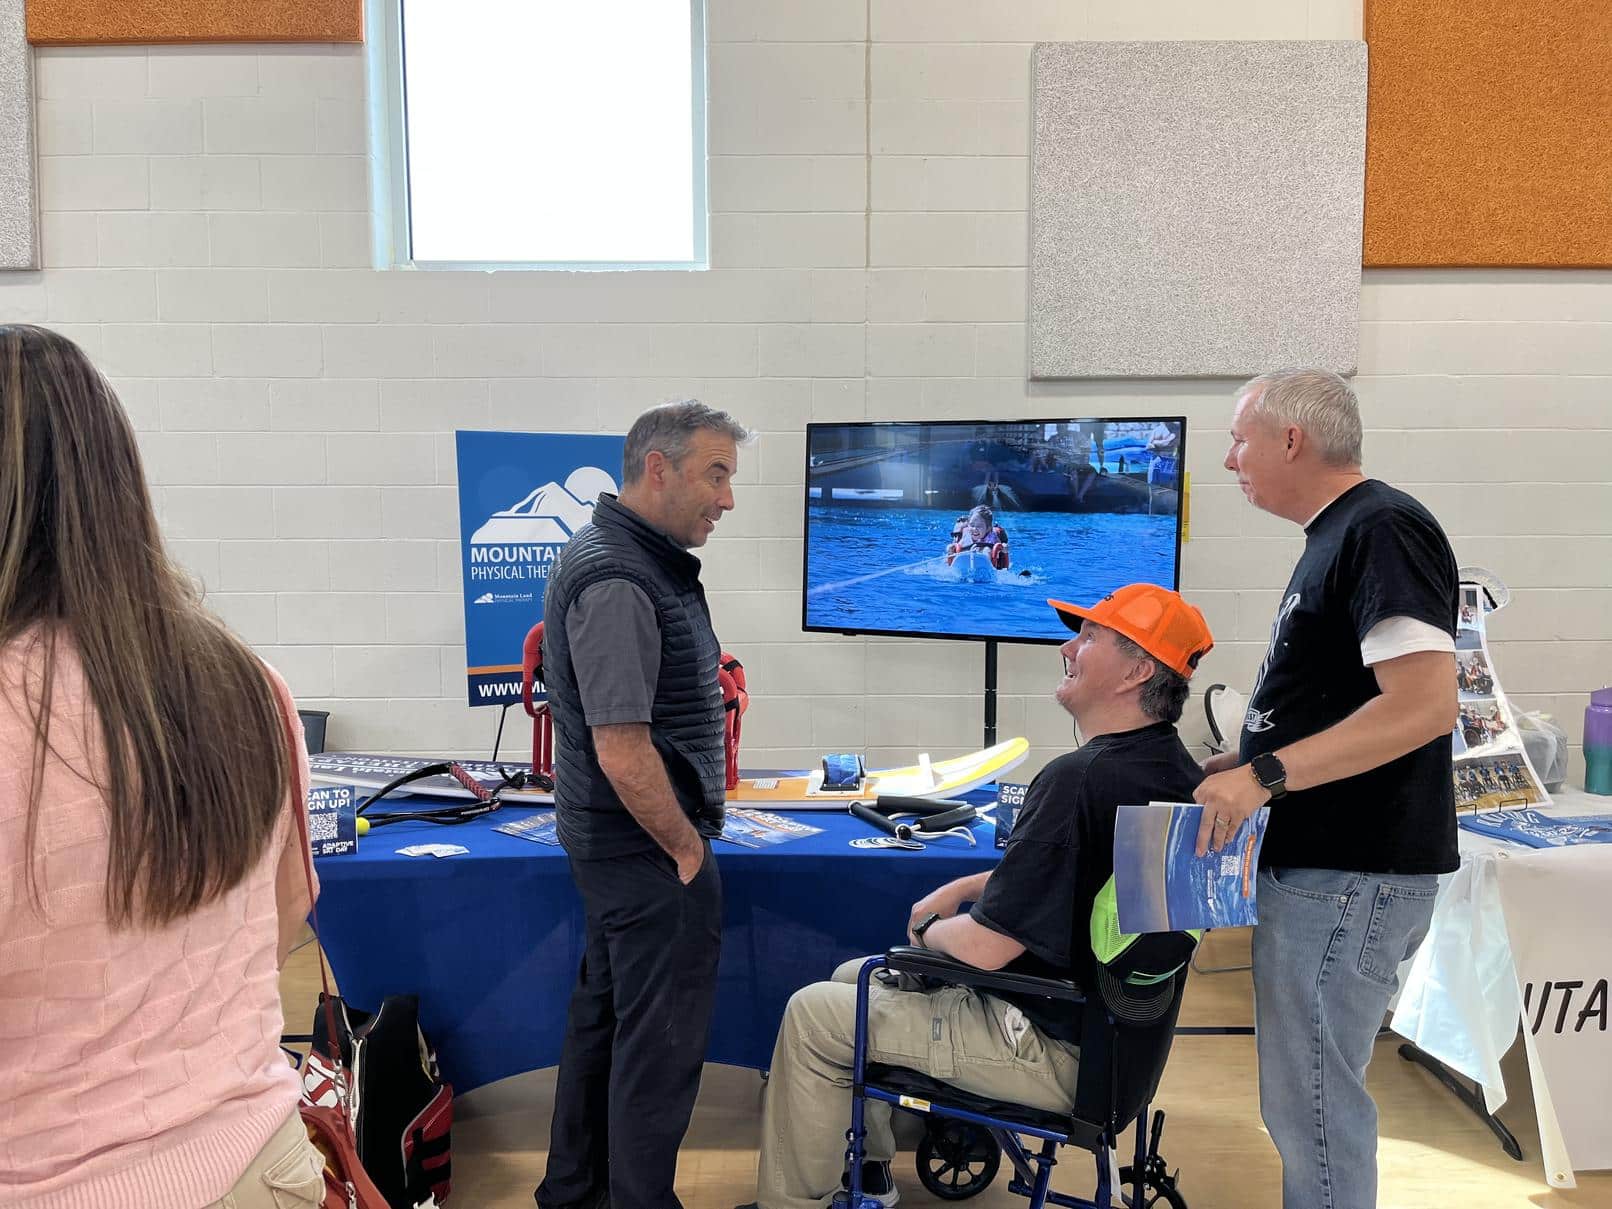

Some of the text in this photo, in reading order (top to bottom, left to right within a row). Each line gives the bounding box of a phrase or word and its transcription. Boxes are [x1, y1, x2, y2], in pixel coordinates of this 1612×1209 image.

[471, 566, 525, 580] PHYSICAL
[308, 789, 349, 800] AN TO
[329, 798, 350, 809] UP!
